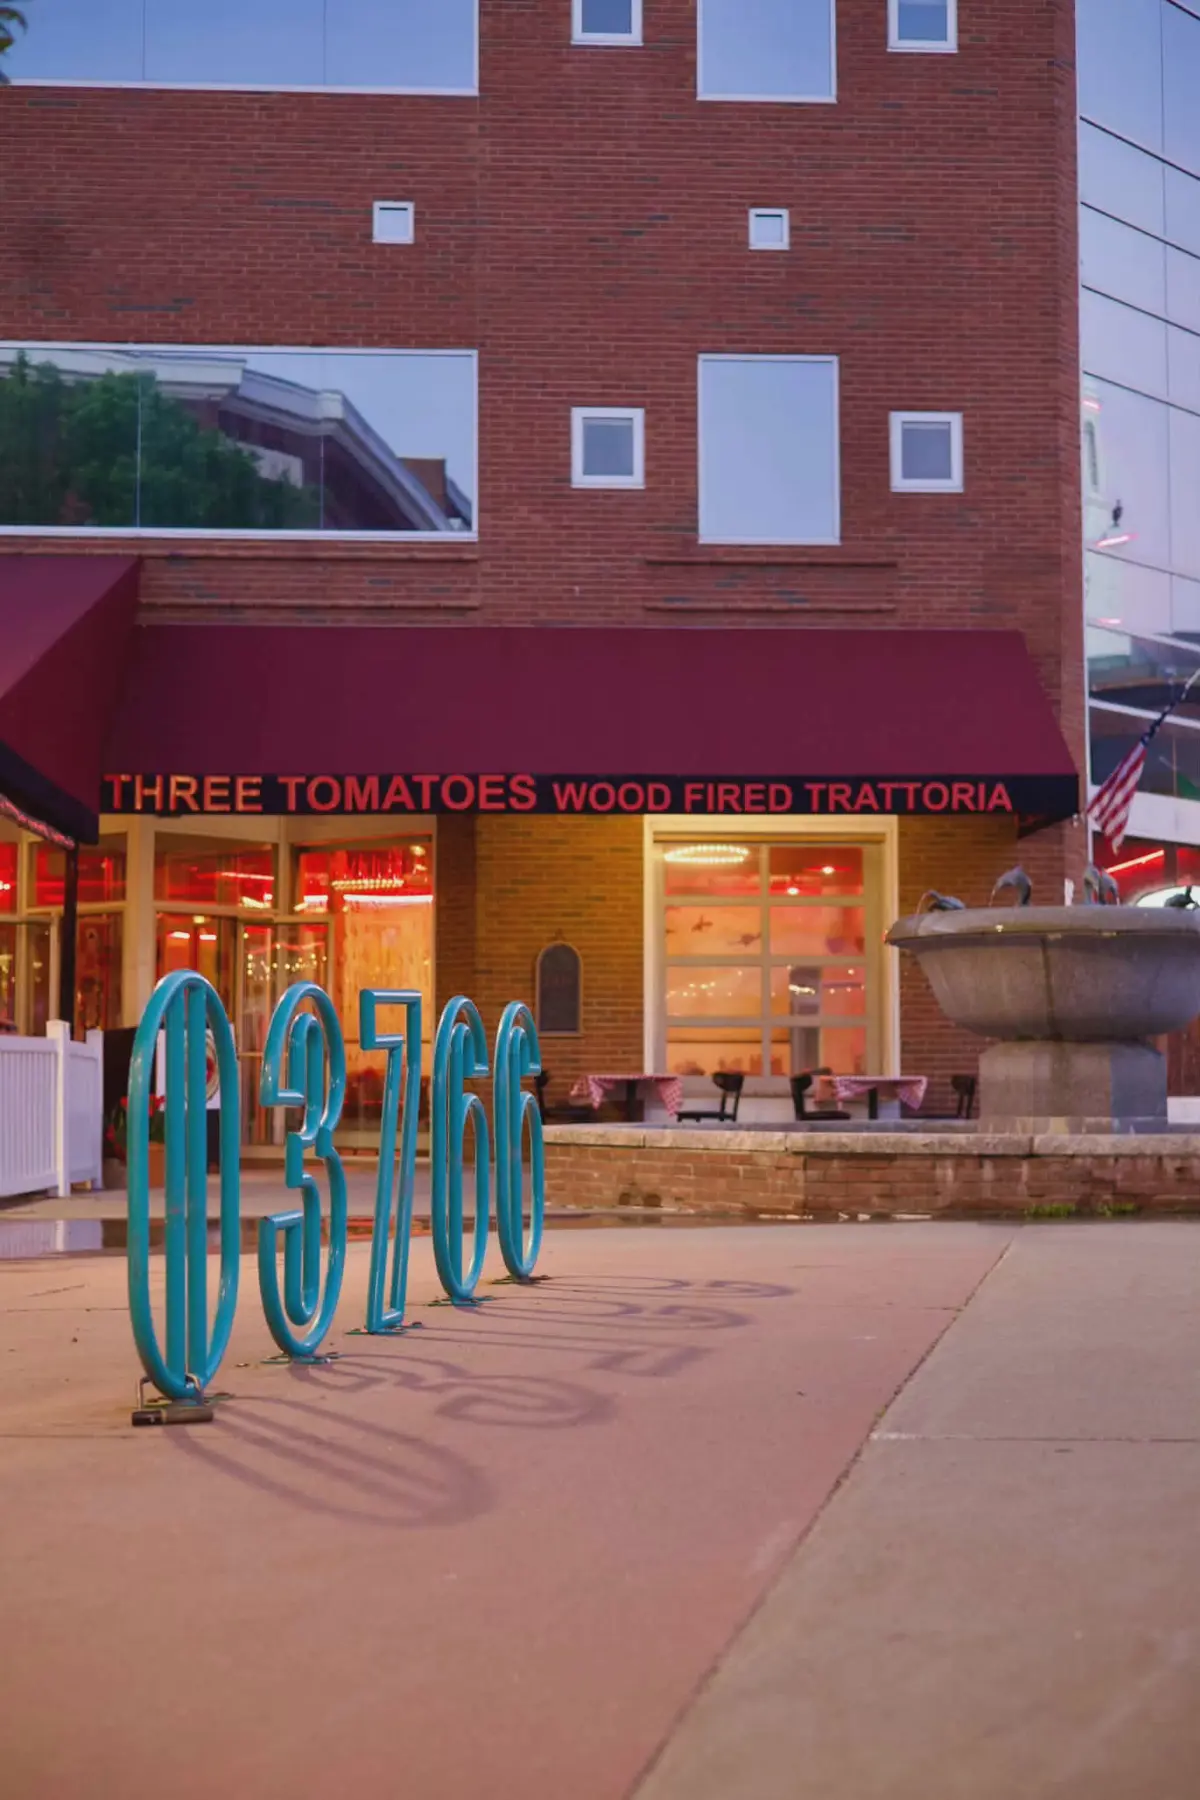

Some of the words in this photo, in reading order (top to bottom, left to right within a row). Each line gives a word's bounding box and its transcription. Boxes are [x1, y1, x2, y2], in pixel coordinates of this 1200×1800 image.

[104, 774, 263, 812] THREE
[278, 774, 537, 812] TOMATOES
[552, 781, 672, 812] WOOD
[684, 781, 793, 812] FIRED
[803, 781, 1013, 812] TRATTORIA
